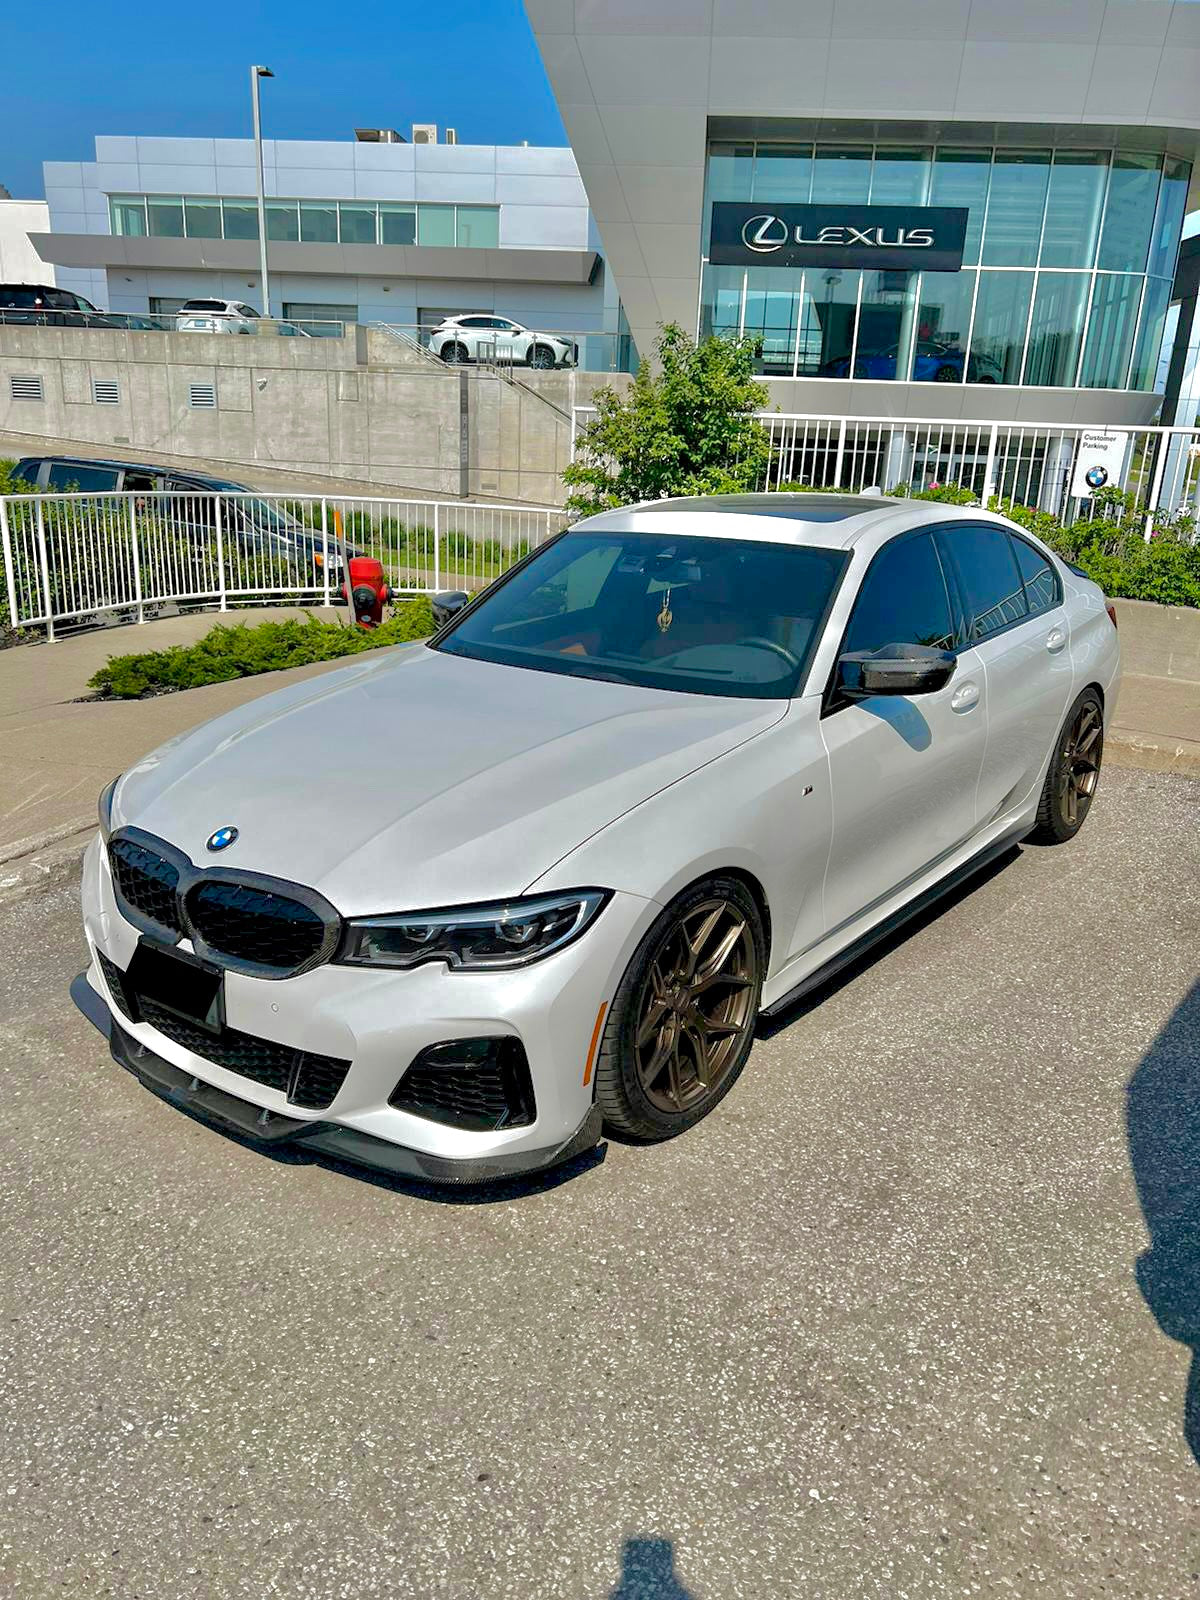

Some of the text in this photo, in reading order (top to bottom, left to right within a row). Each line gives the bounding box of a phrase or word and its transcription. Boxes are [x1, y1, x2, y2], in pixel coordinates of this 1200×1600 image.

[794, 225, 935, 247] LEXUS
[1084, 434, 1116, 442] Customer
[1082, 442, 1108, 450] Parking
